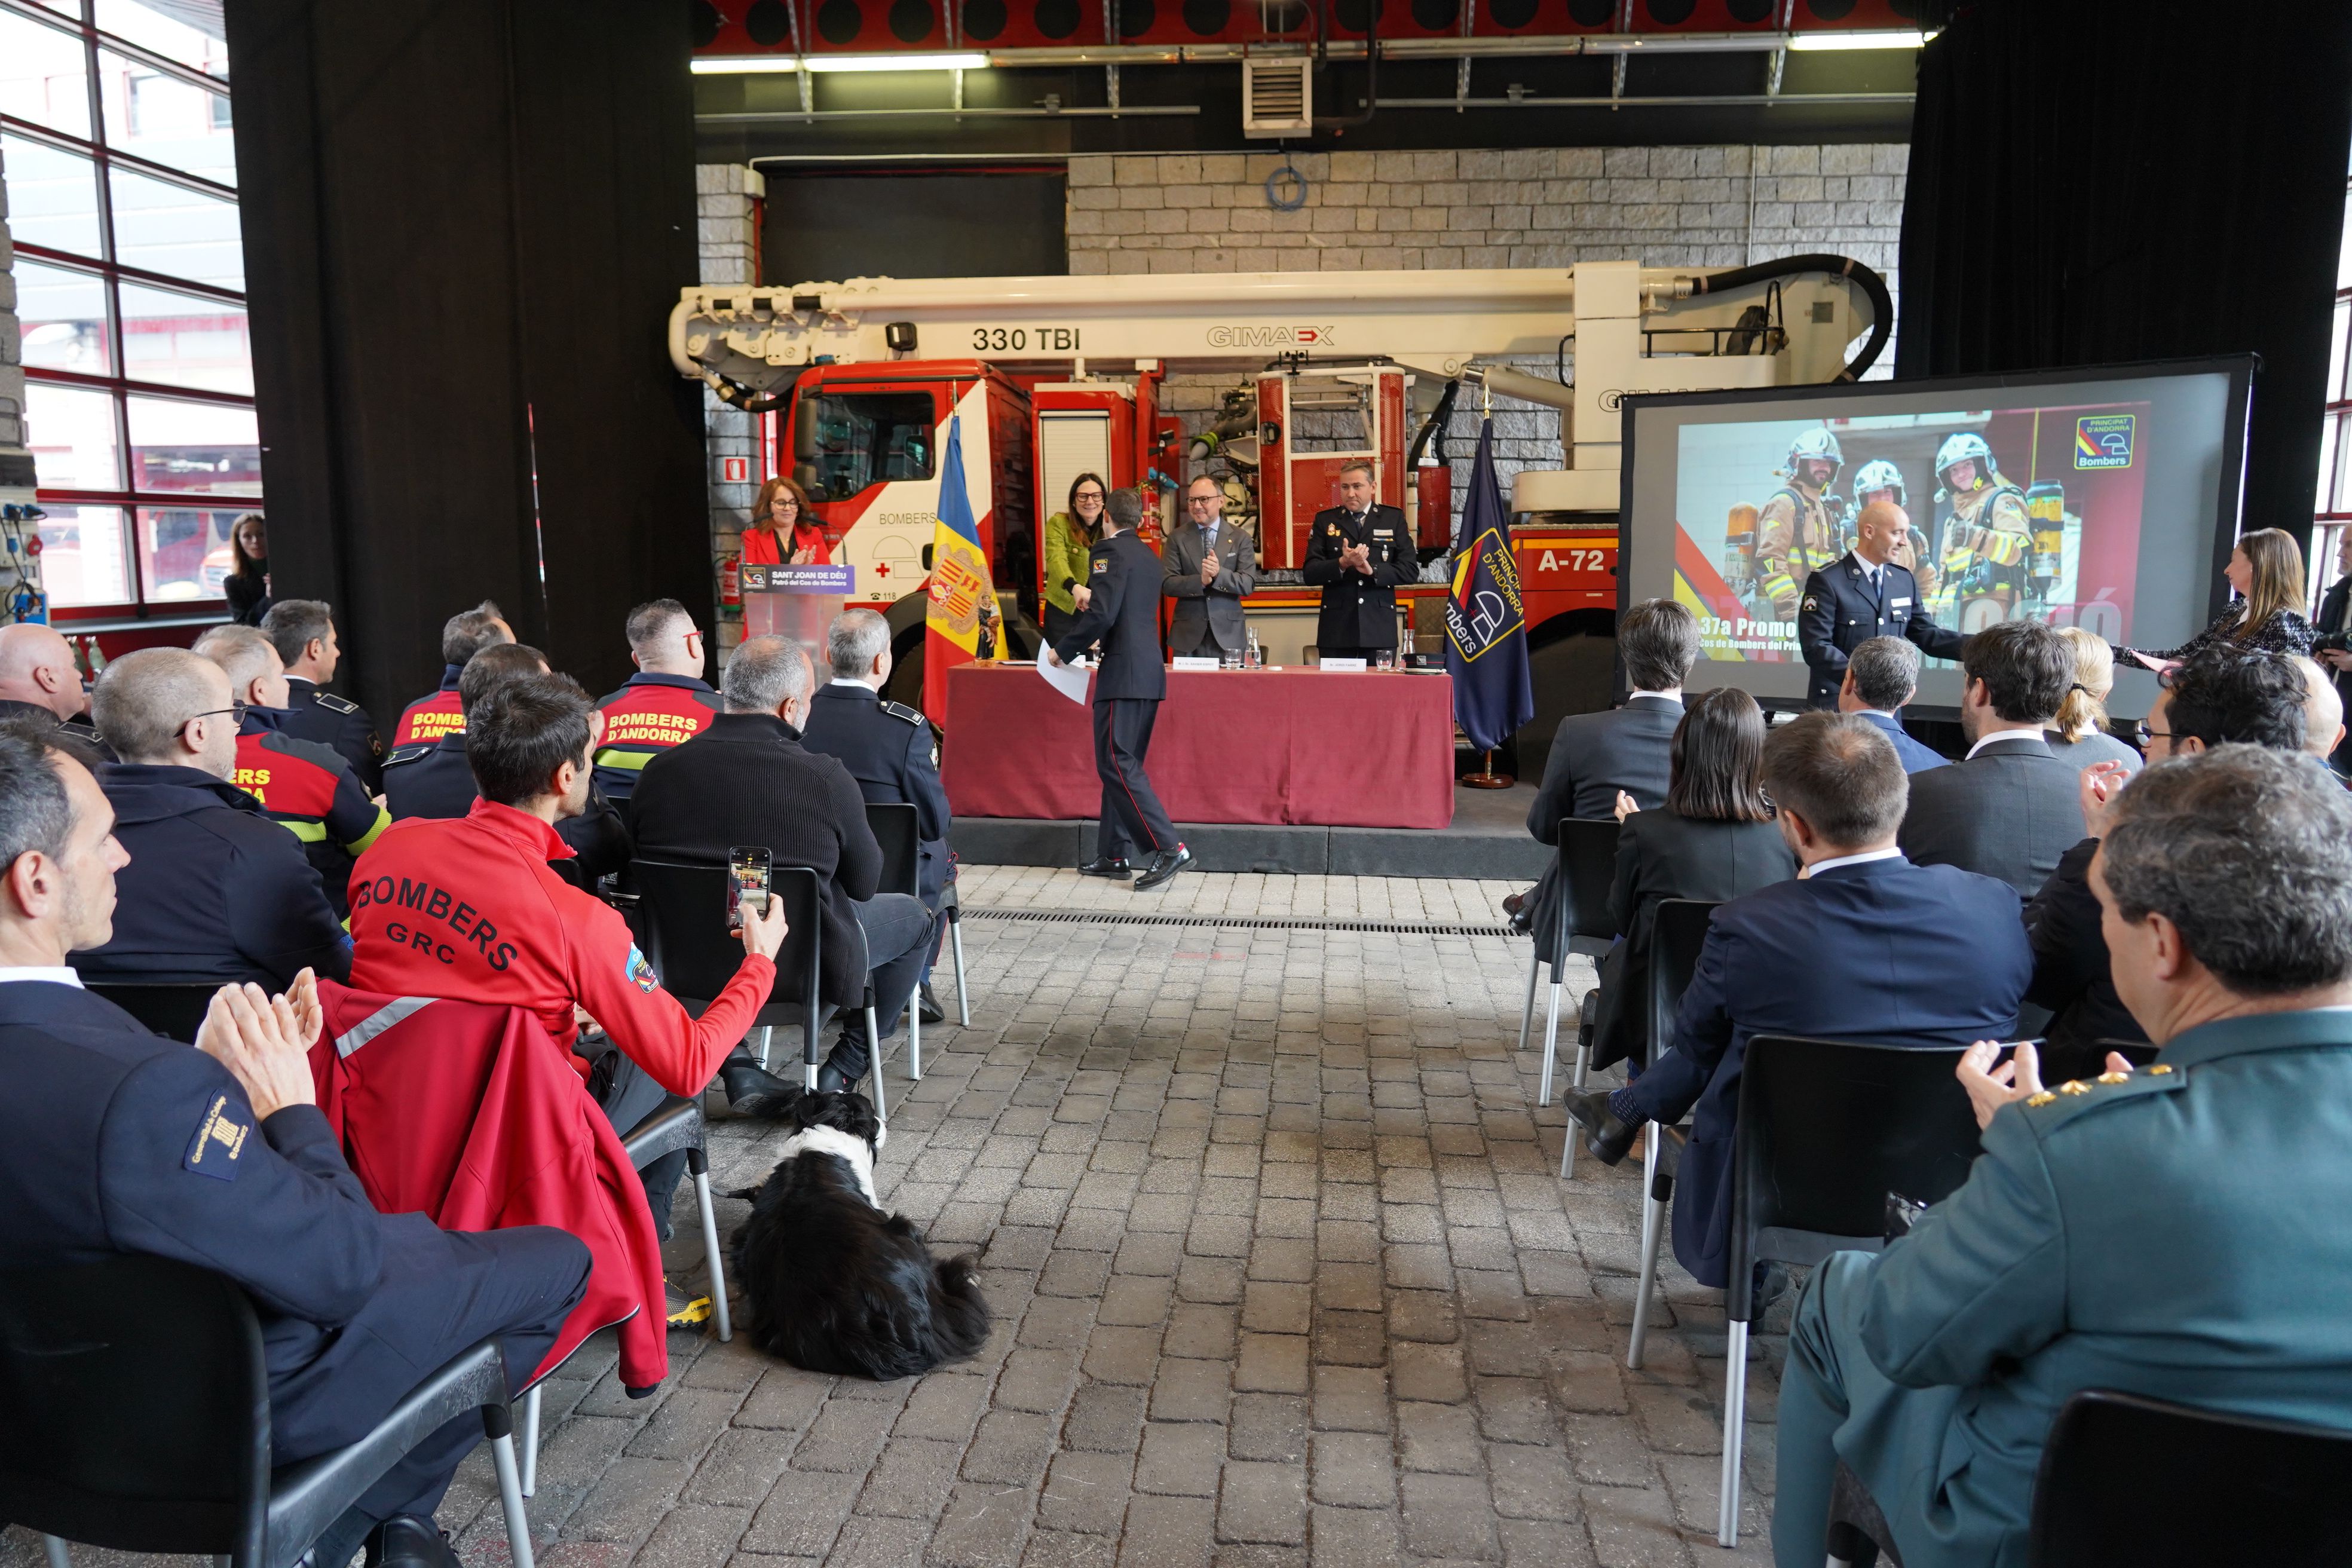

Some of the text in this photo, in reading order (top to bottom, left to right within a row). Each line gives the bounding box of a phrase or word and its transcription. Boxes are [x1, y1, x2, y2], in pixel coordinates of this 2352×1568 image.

[973, 328, 1080, 350] 330 TBI
[1206, 326, 1334, 347] GIMAEX
[2087, 425, 2130, 433] D'ANDORRA
[2079, 457, 2126, 466] Bombers
[879, 512, 938, 525] BOMBERS
[1494, 547, 1521, 590] PRINCI
[1538, 550, 1604, 571] A-72
[830, 571, 847, 580] DÉU
[1482, 552, 1524, 617] D'ANDORRA
[1701, 617, 1797, 638] 37a Promo
[1716, 638, 1726, 648] de
[1728, 639, 1766, 650] Bombers
[1768, 640, 1783, 650] del
[412, 713, 467, 727] BOMB
[609, 713, 698, 731] BOMBERS
[607, 727, 692, 743] D'ANDORRA
[358, 875, 518, 972] BOMBERS
[386, 923, 455, 964] GRC
